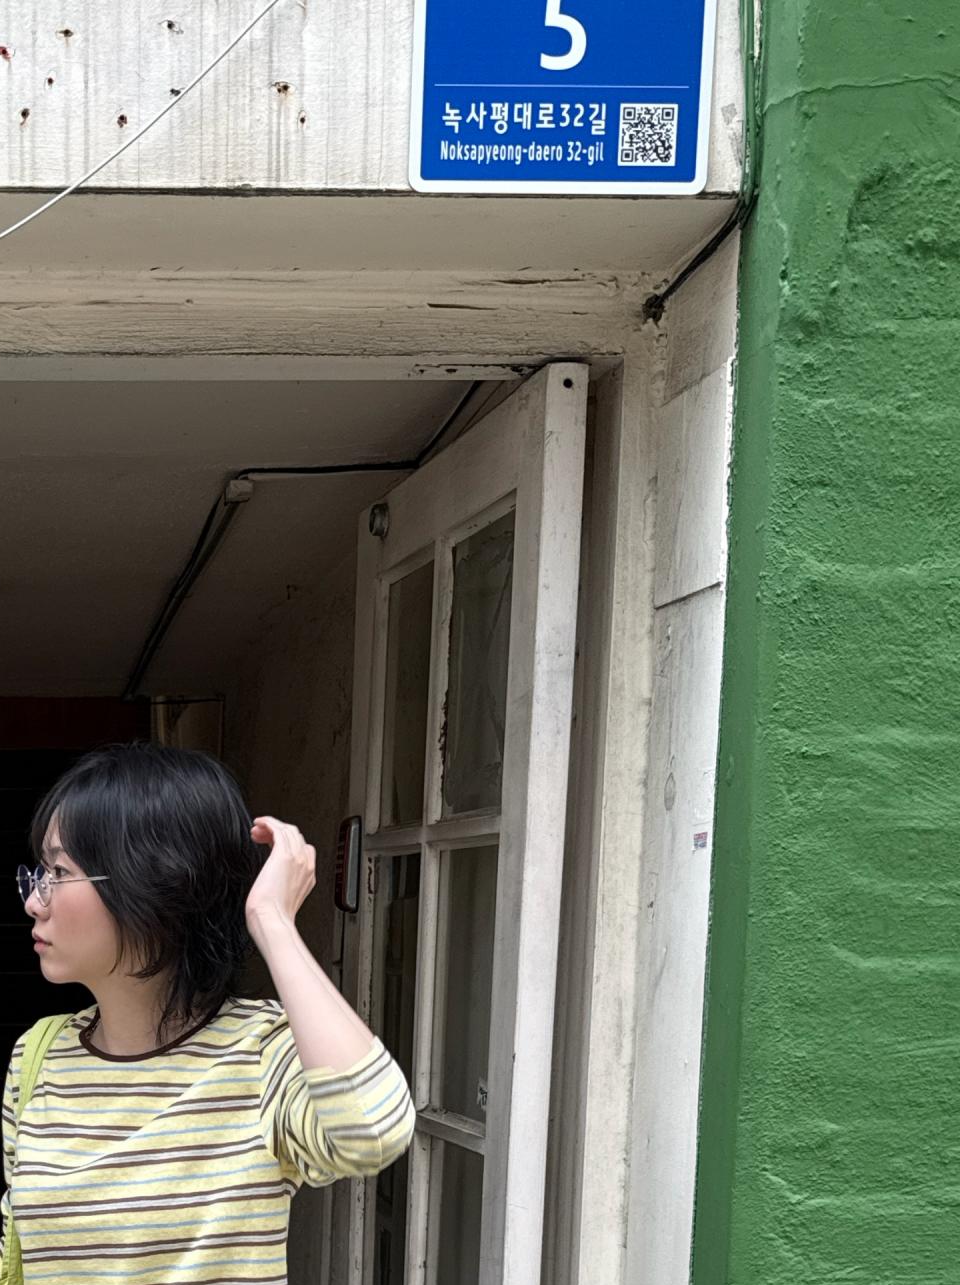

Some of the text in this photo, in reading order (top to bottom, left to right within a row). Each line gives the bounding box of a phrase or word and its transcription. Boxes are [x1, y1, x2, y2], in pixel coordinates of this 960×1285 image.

[540, 0, 587, 71] 5
[442, 102, 607, 135] 녹사평대로32길
[440, 140, 604, 166] Noksapyeong-daero 32-gil
